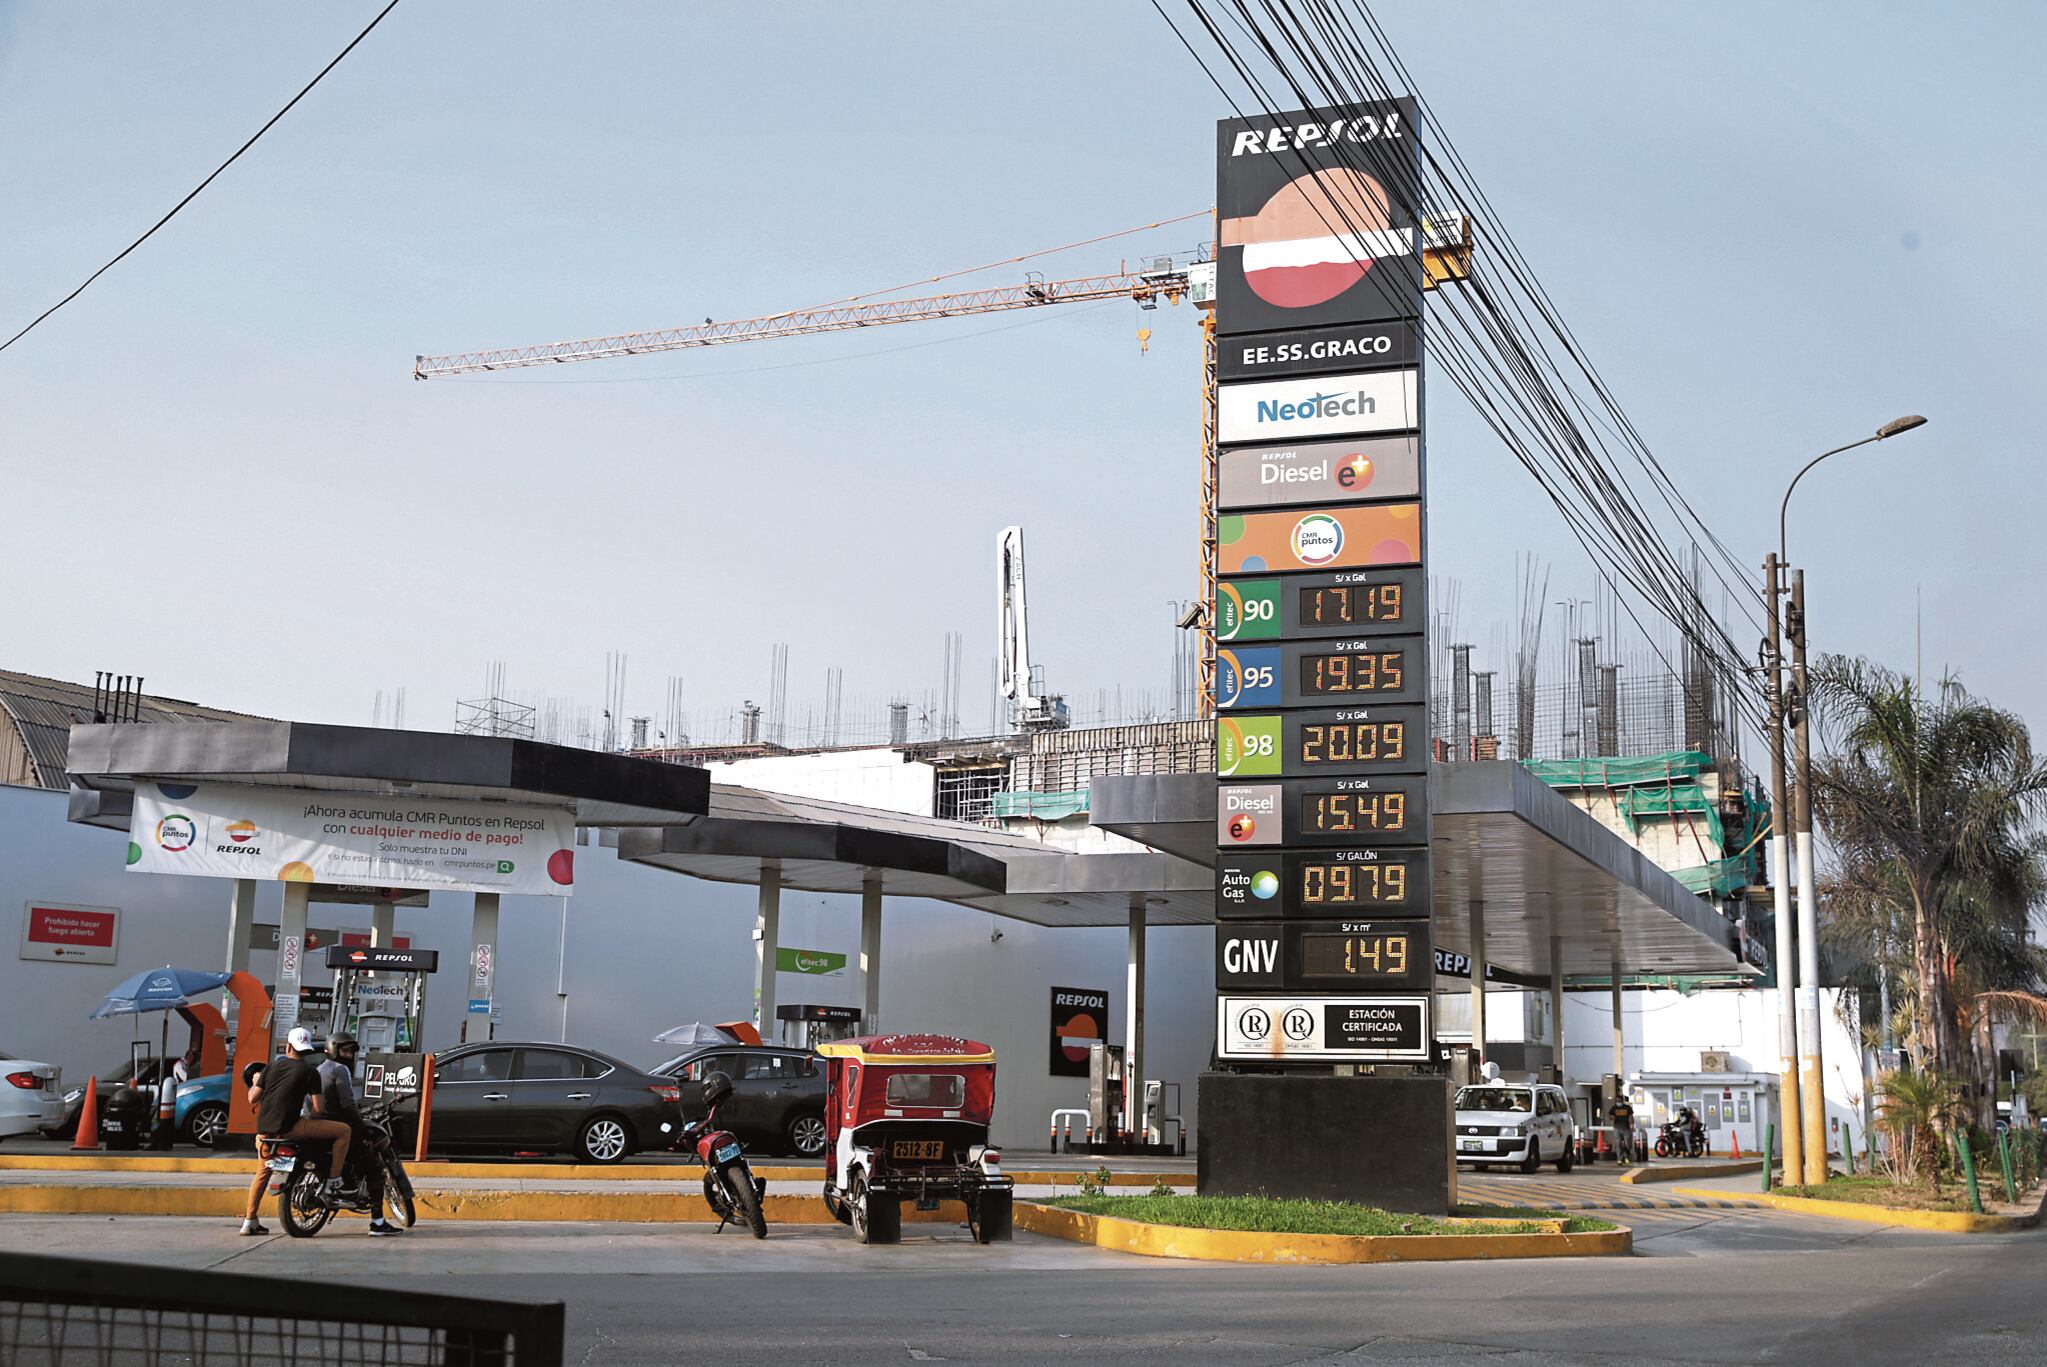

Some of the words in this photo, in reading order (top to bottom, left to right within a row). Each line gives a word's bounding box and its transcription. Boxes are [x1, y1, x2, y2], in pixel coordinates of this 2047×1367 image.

[1232, 113, 1402, 157] REPSOL
[1243, 336, 1392, 365] EE.SS.GRACO
[1262, 452, 1296, 461] REPSOL
[1261, 460, 1328, 484] Diesel
[1301, 537, 1334, 548] puntos
[1335, 574, 1344, 582] S/
[1352, 573, 1366, 581] Gal
[1244, 599, 1274, 622] 90
[1336, 642, 1345, 651] S/
[1353, 641, 1367, 650] Gal
[1244, 666, 1273, 688] 95
[1336, 712, 1346, 720] S/
[1354, 711, 1368, 719] Gal
[1243, 734, 1274, 756] 98
[1338, 781, 1346, 790] S/
[1355, 780, 1369, 789] Gal
[1227, 795, 1273, 810] Diesel
[304, 805, 346, 818] ¡Ahora
[349, 809, 403, 821] acumula
[406, 811, 435, 824] CMR
[439, 813, 481, 827] Puntos
[485, 819, 500, 827] en
[504, 817, 544, 831] Repsol
[323, 824, 346, 834] con
[350, 825, 415, 839] cualquier
[418, 829, 462, 840] medio
[466, 831, 482, 842] de
[486, 834, 523, 846] pago!
[217, 845, 261, 855] REPSOL
[378, 842, 398, 852] Solo
[400, 845, 437, 854] muestra
[451, 847, 467, 856] DNI
[1336, 852, 1346, 861] S/
[1347, 850, 1377, 860] GALÓN
[444, 860, 495, 869] cmrpuntos.pe
[1222, 874, 1250, 885] Auto
[1223, 887, 1244, 898] Gas
[45, 916, 79, 926] Prohibido
[48, 927, 68, 936] fuego
[1342, 924, 1351, 932] S/
[1224, 939, 1278, 973] GNV
[1434, 952, 1493, 977] REPSL
[1056, 994, 1104, 1008] REPSOL
[1349, 1008, 1395, 1018] ESTACIÓN
[1342, 1022, 1403, 1031] CERTIFICADA
